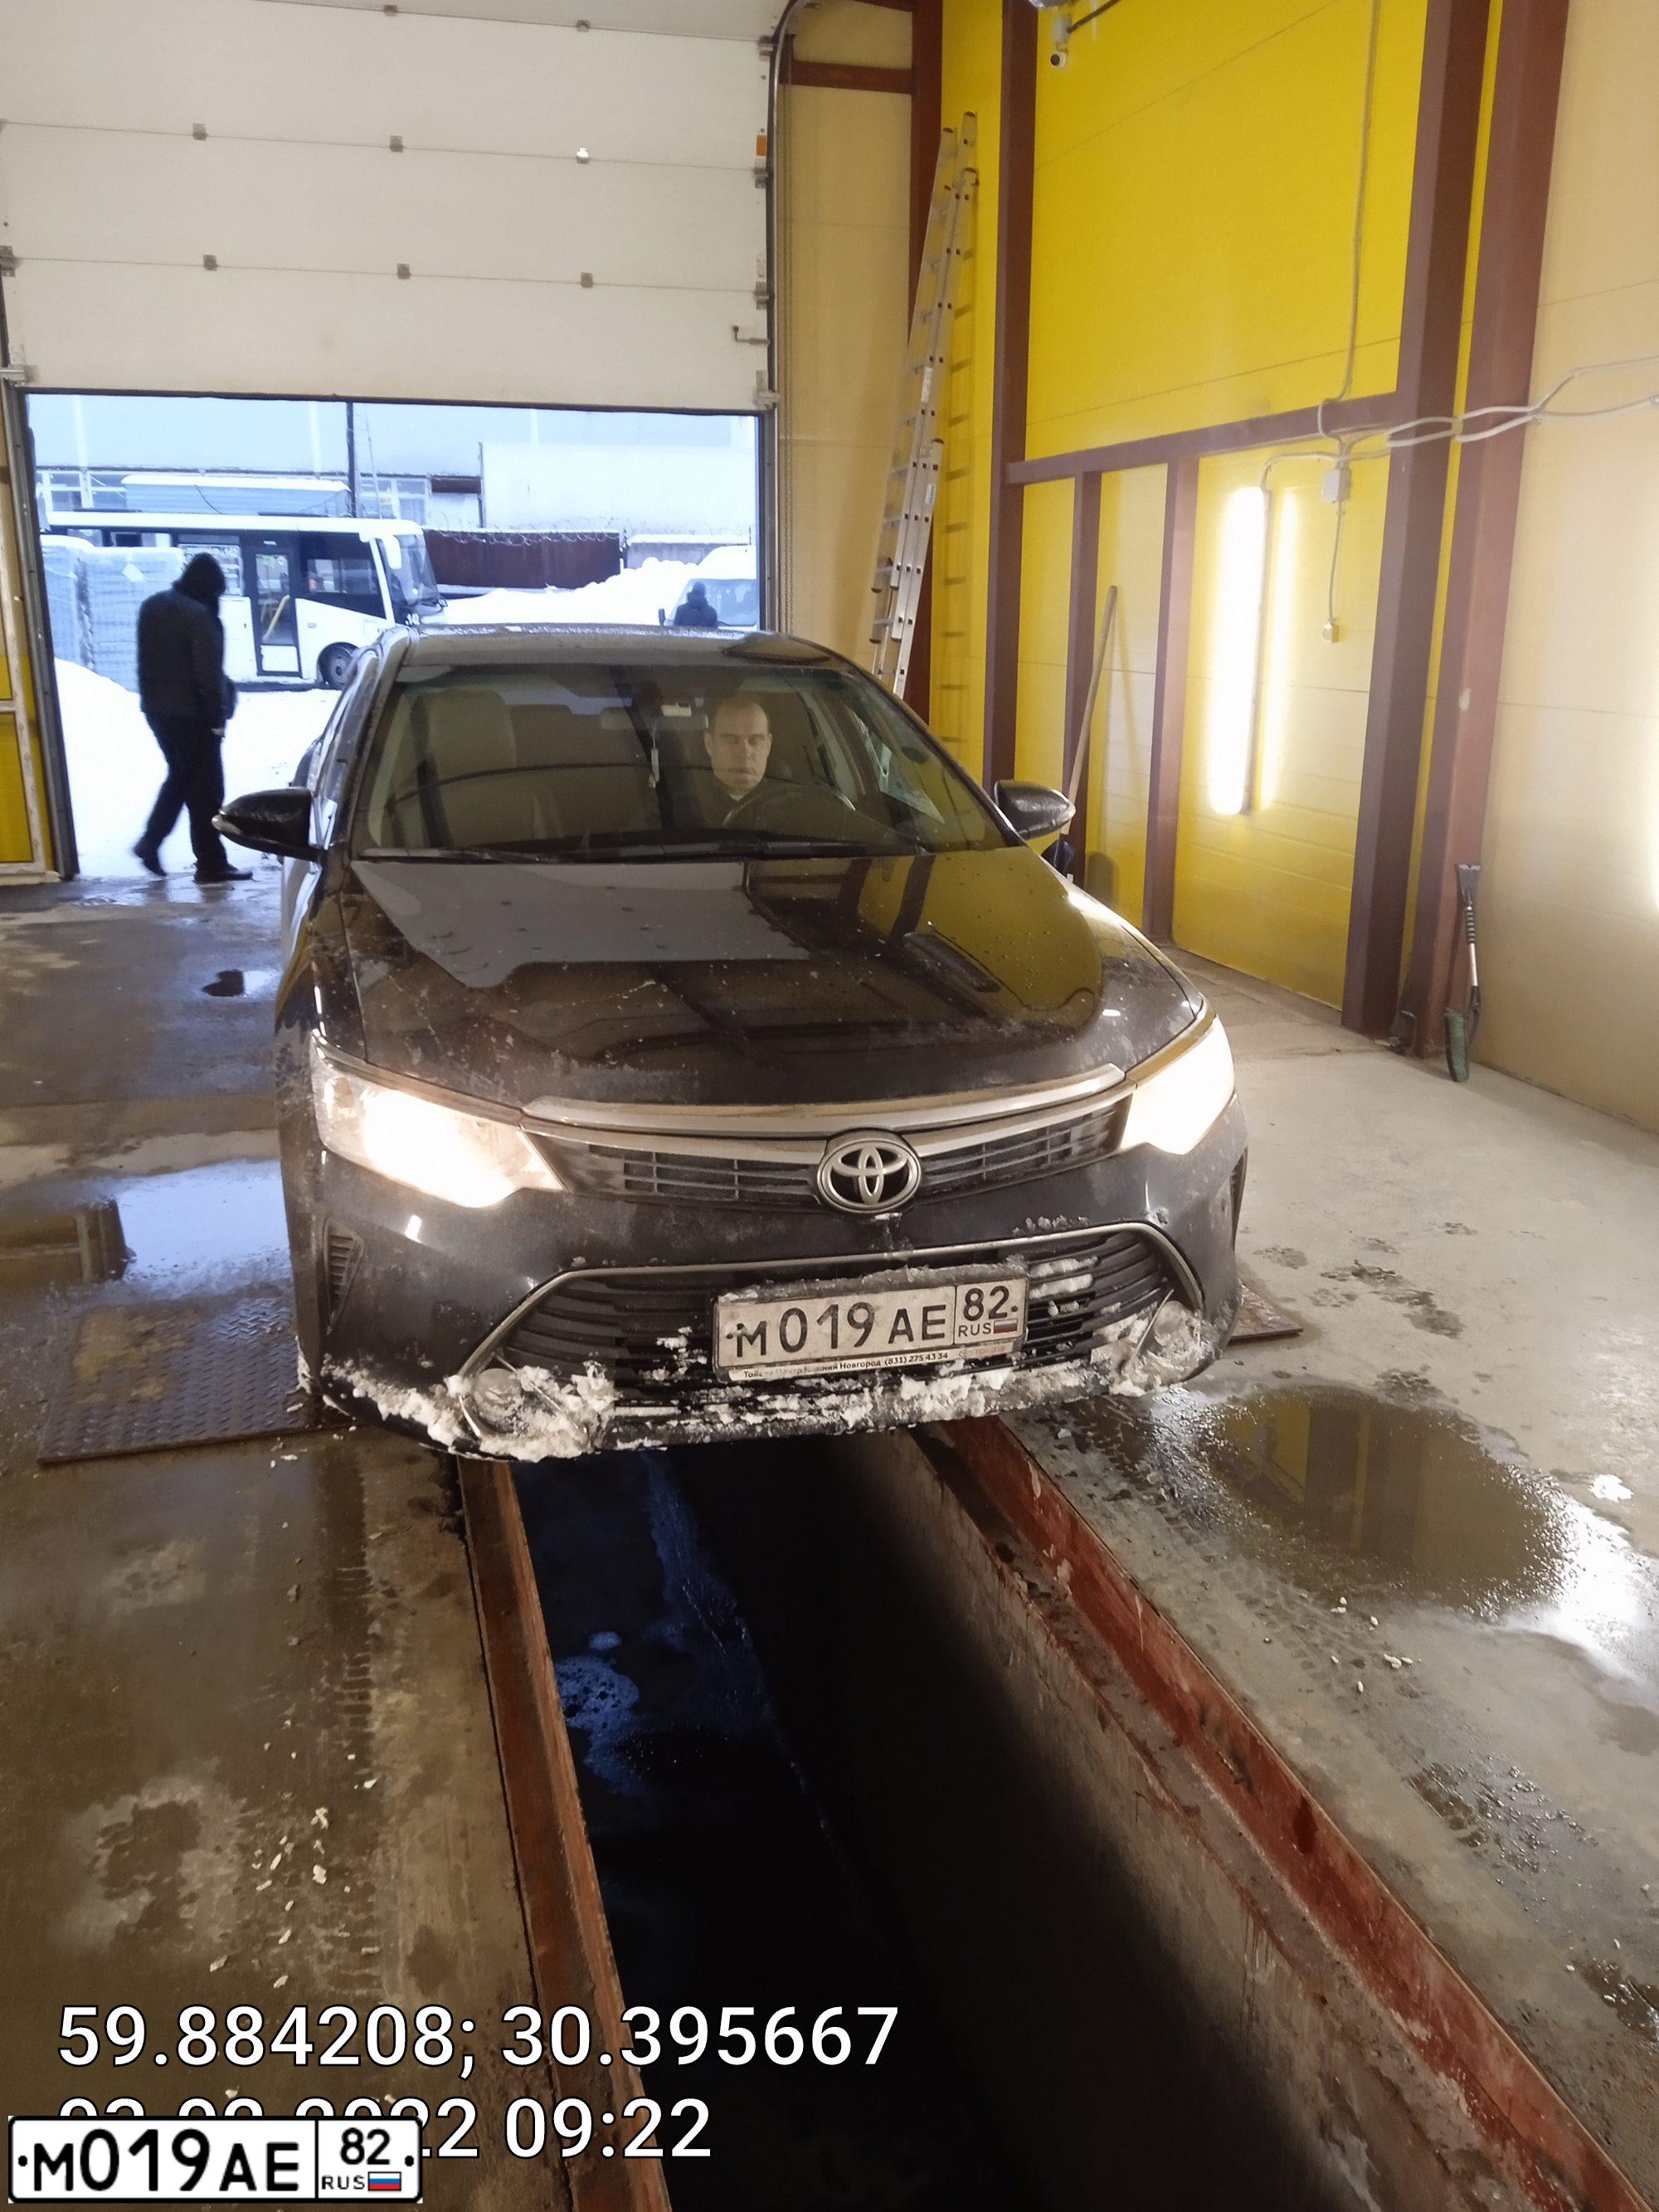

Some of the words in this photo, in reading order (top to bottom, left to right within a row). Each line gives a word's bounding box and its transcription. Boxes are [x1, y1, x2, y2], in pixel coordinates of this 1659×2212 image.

[962, 1285, 1009, 1323] 82
[957, 1323, 992, 1337] RUS
[839, 1359, 881, 1370] Новгород
[884, 1357, 907, 1367] (831)
[908, 1355, 924, 1363] 275
